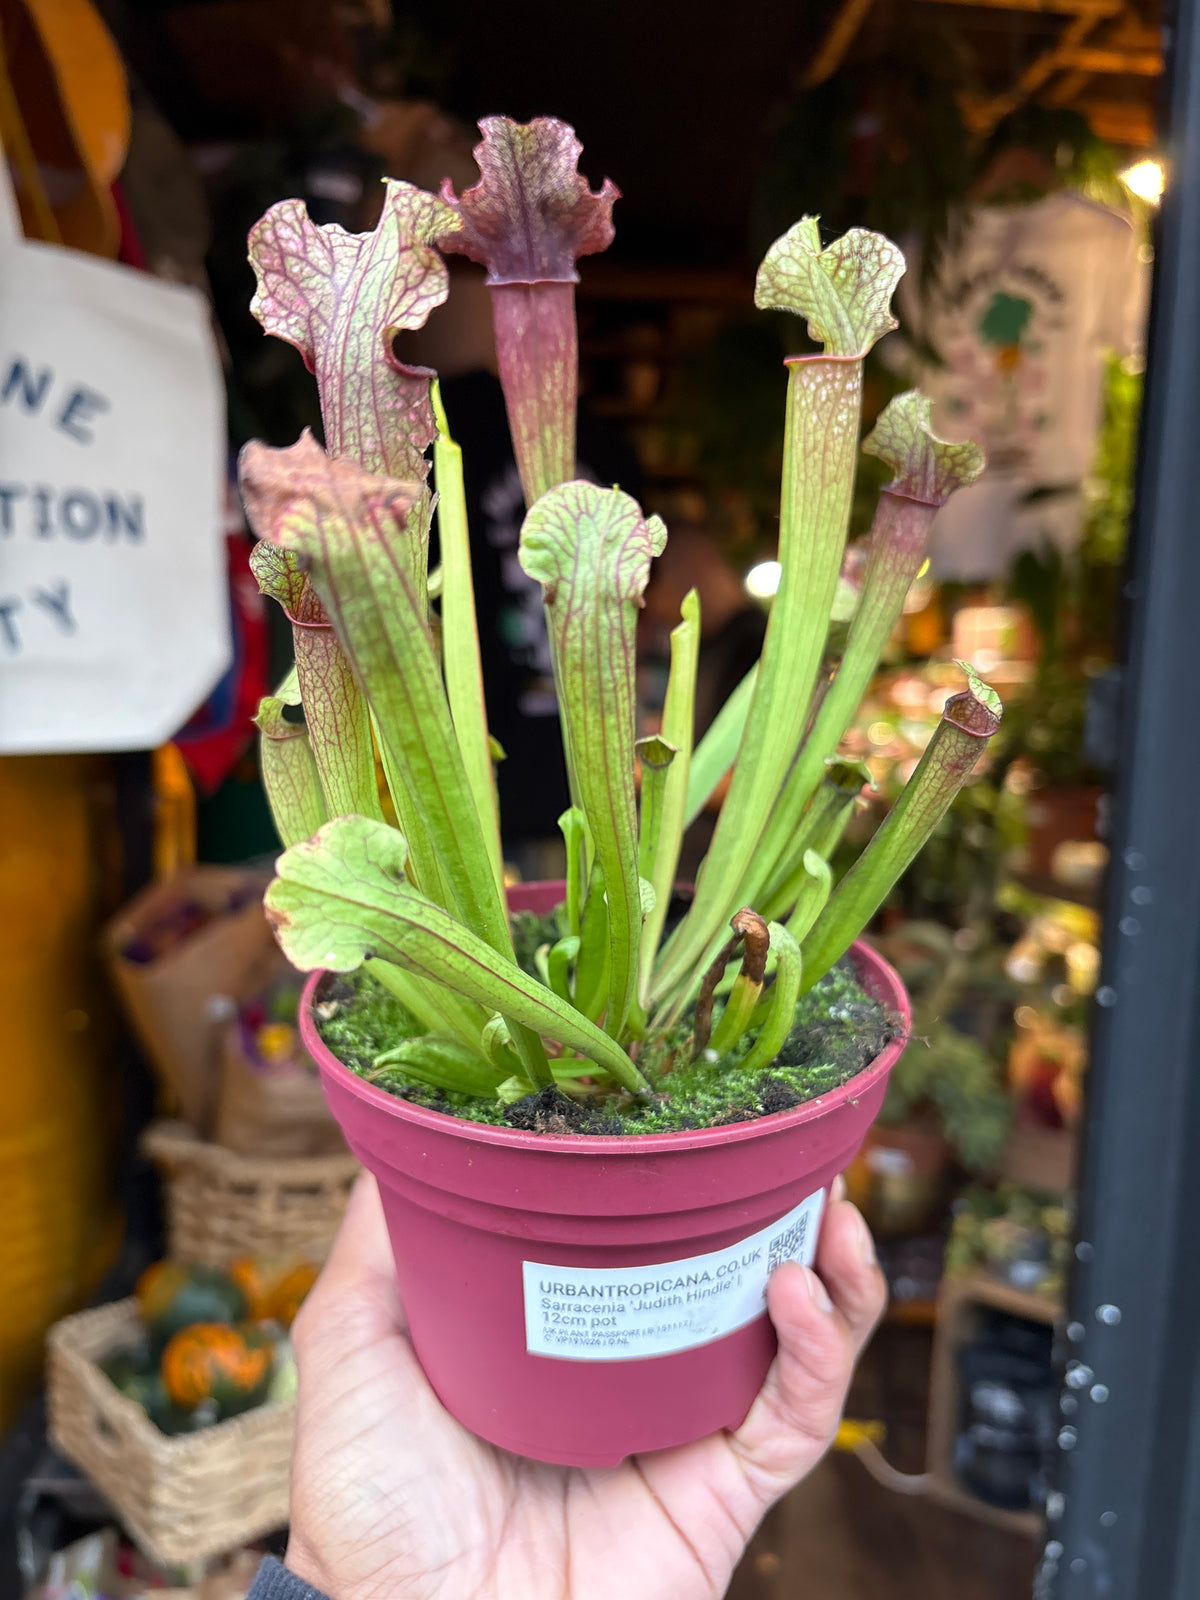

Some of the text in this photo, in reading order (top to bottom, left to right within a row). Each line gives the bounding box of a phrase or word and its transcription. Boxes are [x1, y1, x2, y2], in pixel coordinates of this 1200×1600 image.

[539, 1247, 762, 1297] URBANTROPICANA.CO.UK
[541, 1297, 626, 1313] Sarracenia
[629, 1294, 682, 1312] 'Judith
[686, 1276, 735, 1302] Hindle'
[543, 1311, 618, 1328] 12cm pot
[558, 1328, 589, 1337] PLANT
[591, 1329, 641, 1338] PASSPORT
